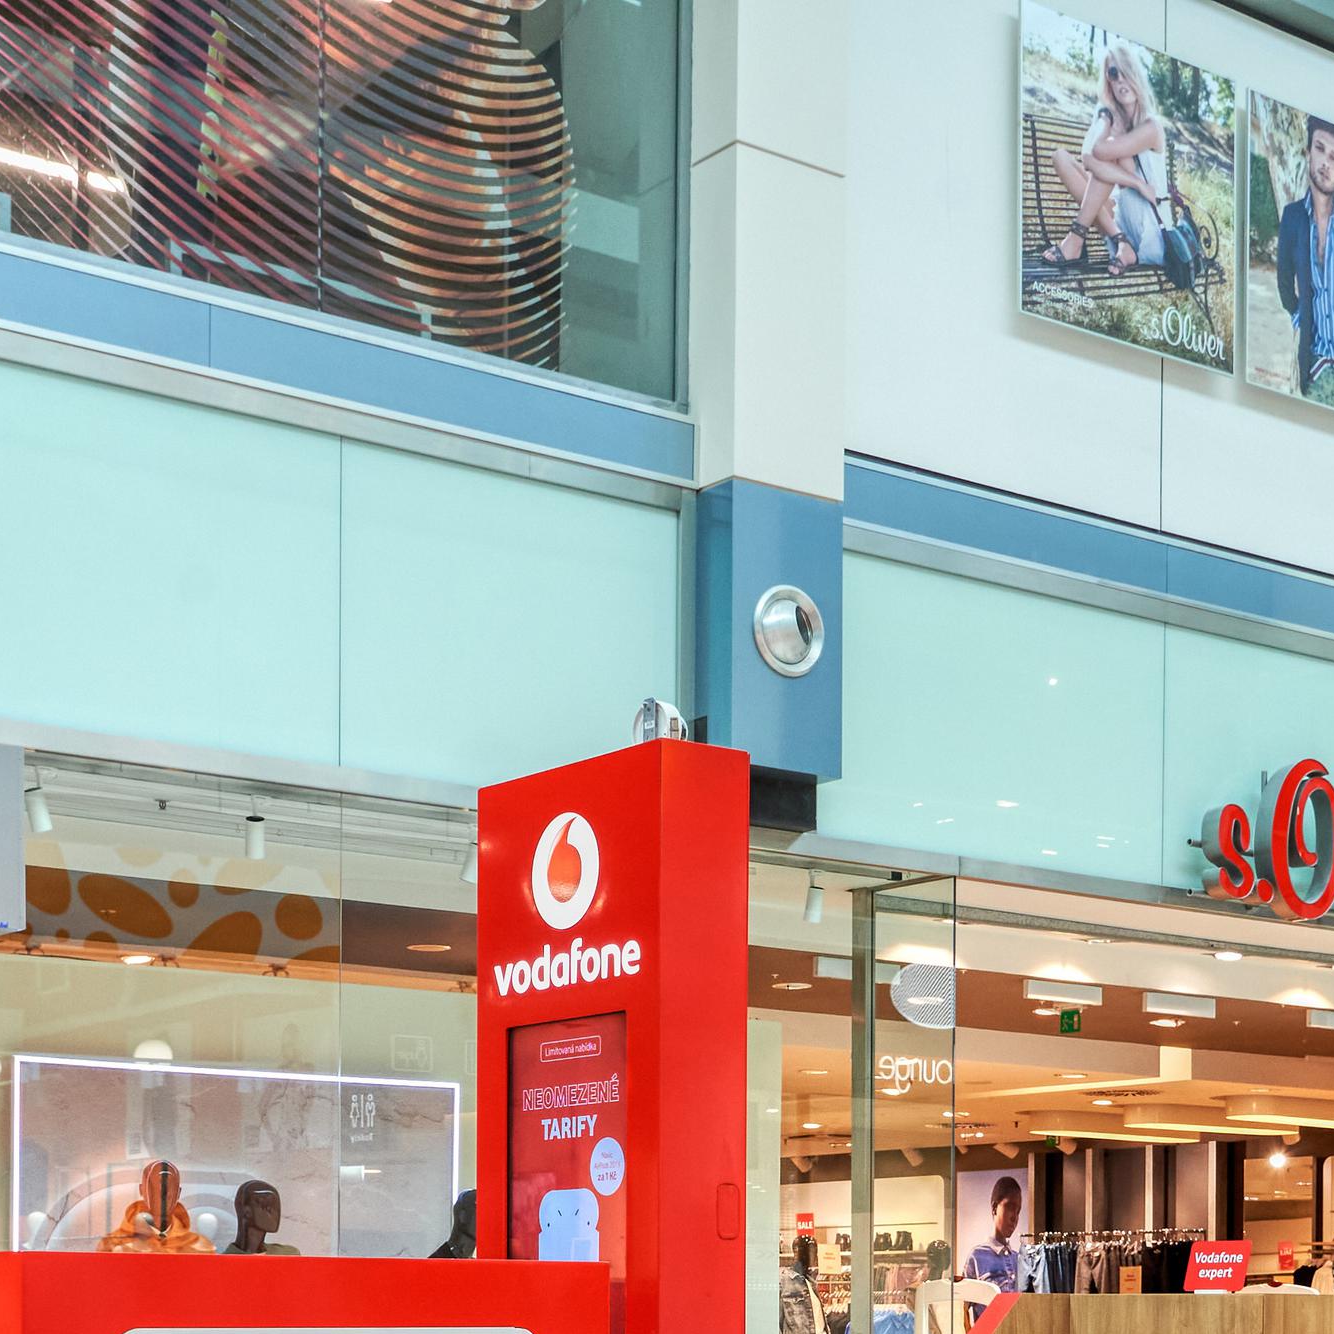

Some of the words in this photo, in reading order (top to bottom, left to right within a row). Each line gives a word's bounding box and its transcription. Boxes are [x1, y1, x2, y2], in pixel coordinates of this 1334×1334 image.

[493, 936, 641, 997] vodafone
[522, 1073, 620, 1112] NEOMEZENÉ
[541, 1114, 598, 1141] TARIFY
[797, 1221, 813, 1230] SALE
[1195, 1252, 1244, 1264] Vodafone
[1198, 1266, 1233, 1280] expert
